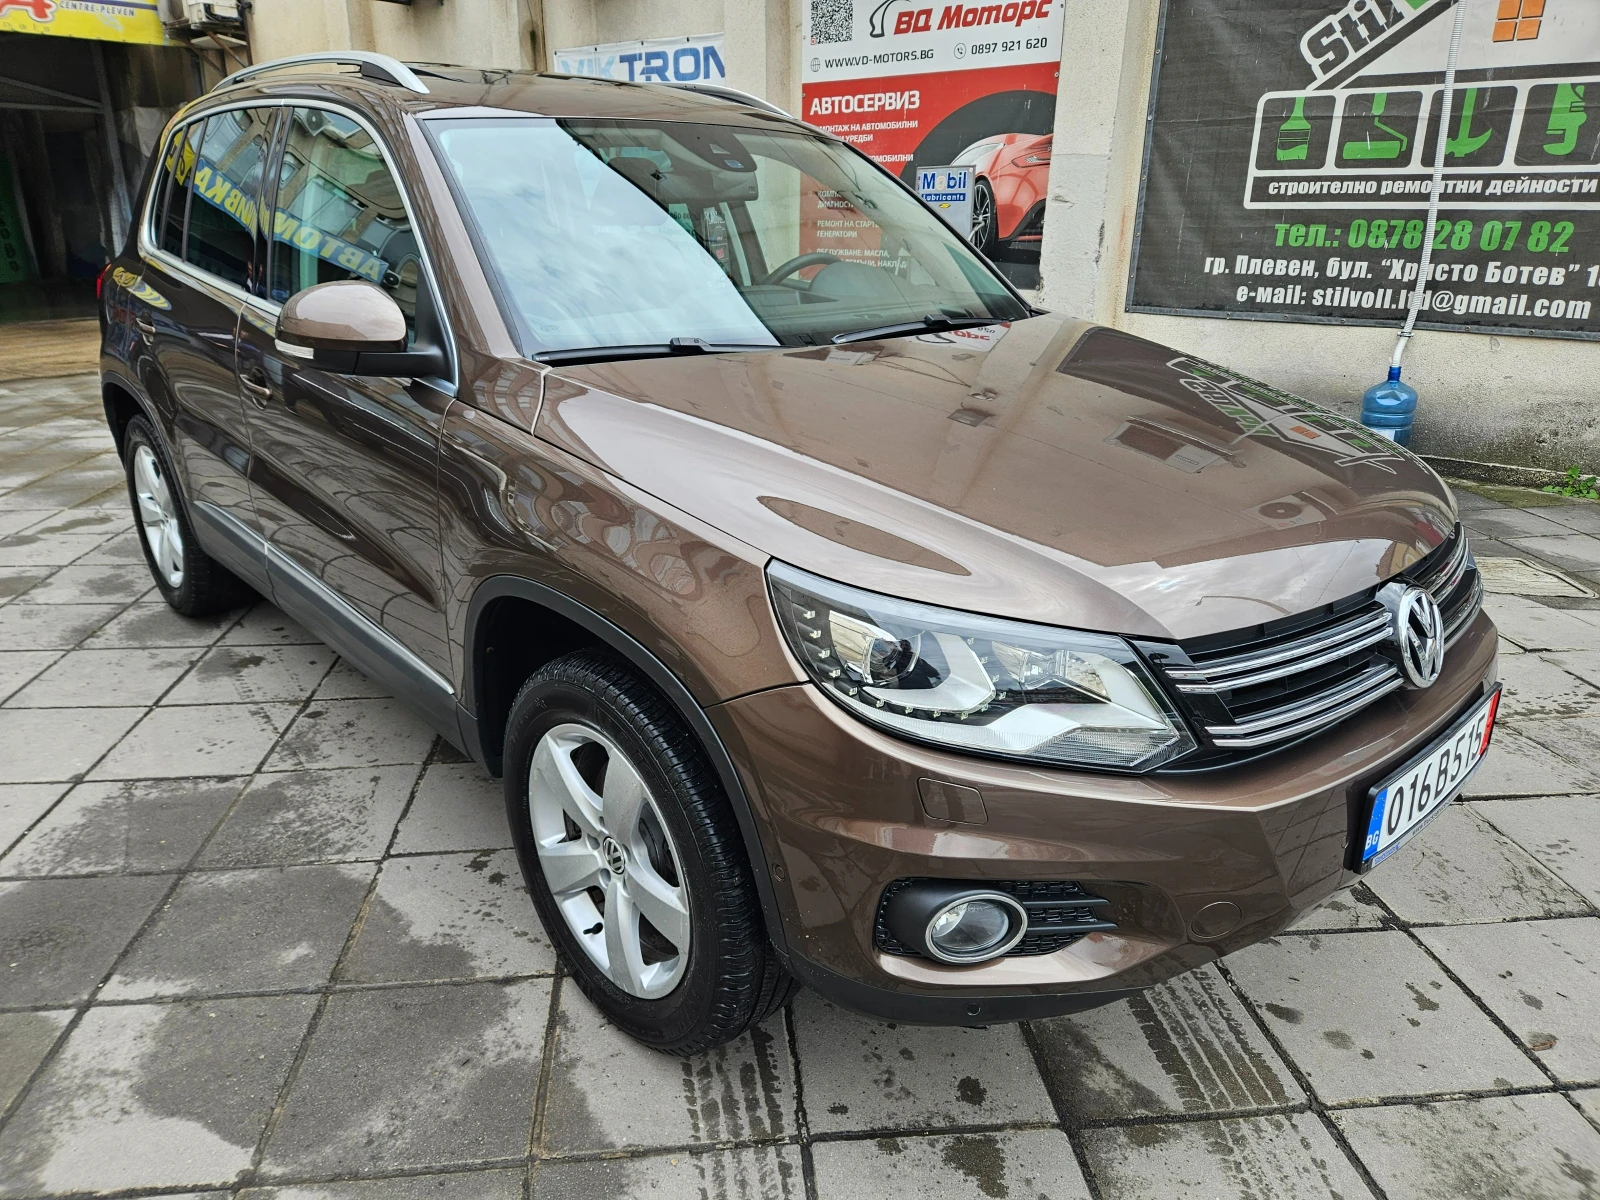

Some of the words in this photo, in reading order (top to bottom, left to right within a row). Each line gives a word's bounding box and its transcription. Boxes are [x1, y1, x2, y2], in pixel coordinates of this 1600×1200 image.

[59, 1, 136, 16] CENTRE-PLEVEN
[937, 0, 1053, 31] Моторс
[971, 42, 998, 55] 0897
[1001, 39, 1021, 52] 921
[1025, 37, 1048, 50] 620
[824, 48, 935, 69] WWW.VD-MOTORS.BG
[809, 89, 920, 116] АВТОСЕРВИЗ
[850, 123, 861, 131] НА
[861, 120, 919, 131] АВТОМОБИЛНИ
[922, 171, 967, 190] Mobil
[1268, 179, 1377, 196] строително
[1485, 174, 1599, 197] дейности
[817, 219, 844, 228] РЕМОНТ
[1274, 222, 1341, 248] тел.:
[1348, 219, 1425, 250] 0878
[1432, 219, 1473, 251] 28
[1479, 220, 1522, 252] 07
[1526, 220, 1575, 253] 82
[1203, 256, 1230, 275] гр.
[1234, 255, 1320, 279] Плевен,
[1325, 257, 1373, 280] бул.
[1365, 830, 1380, 850] BG
